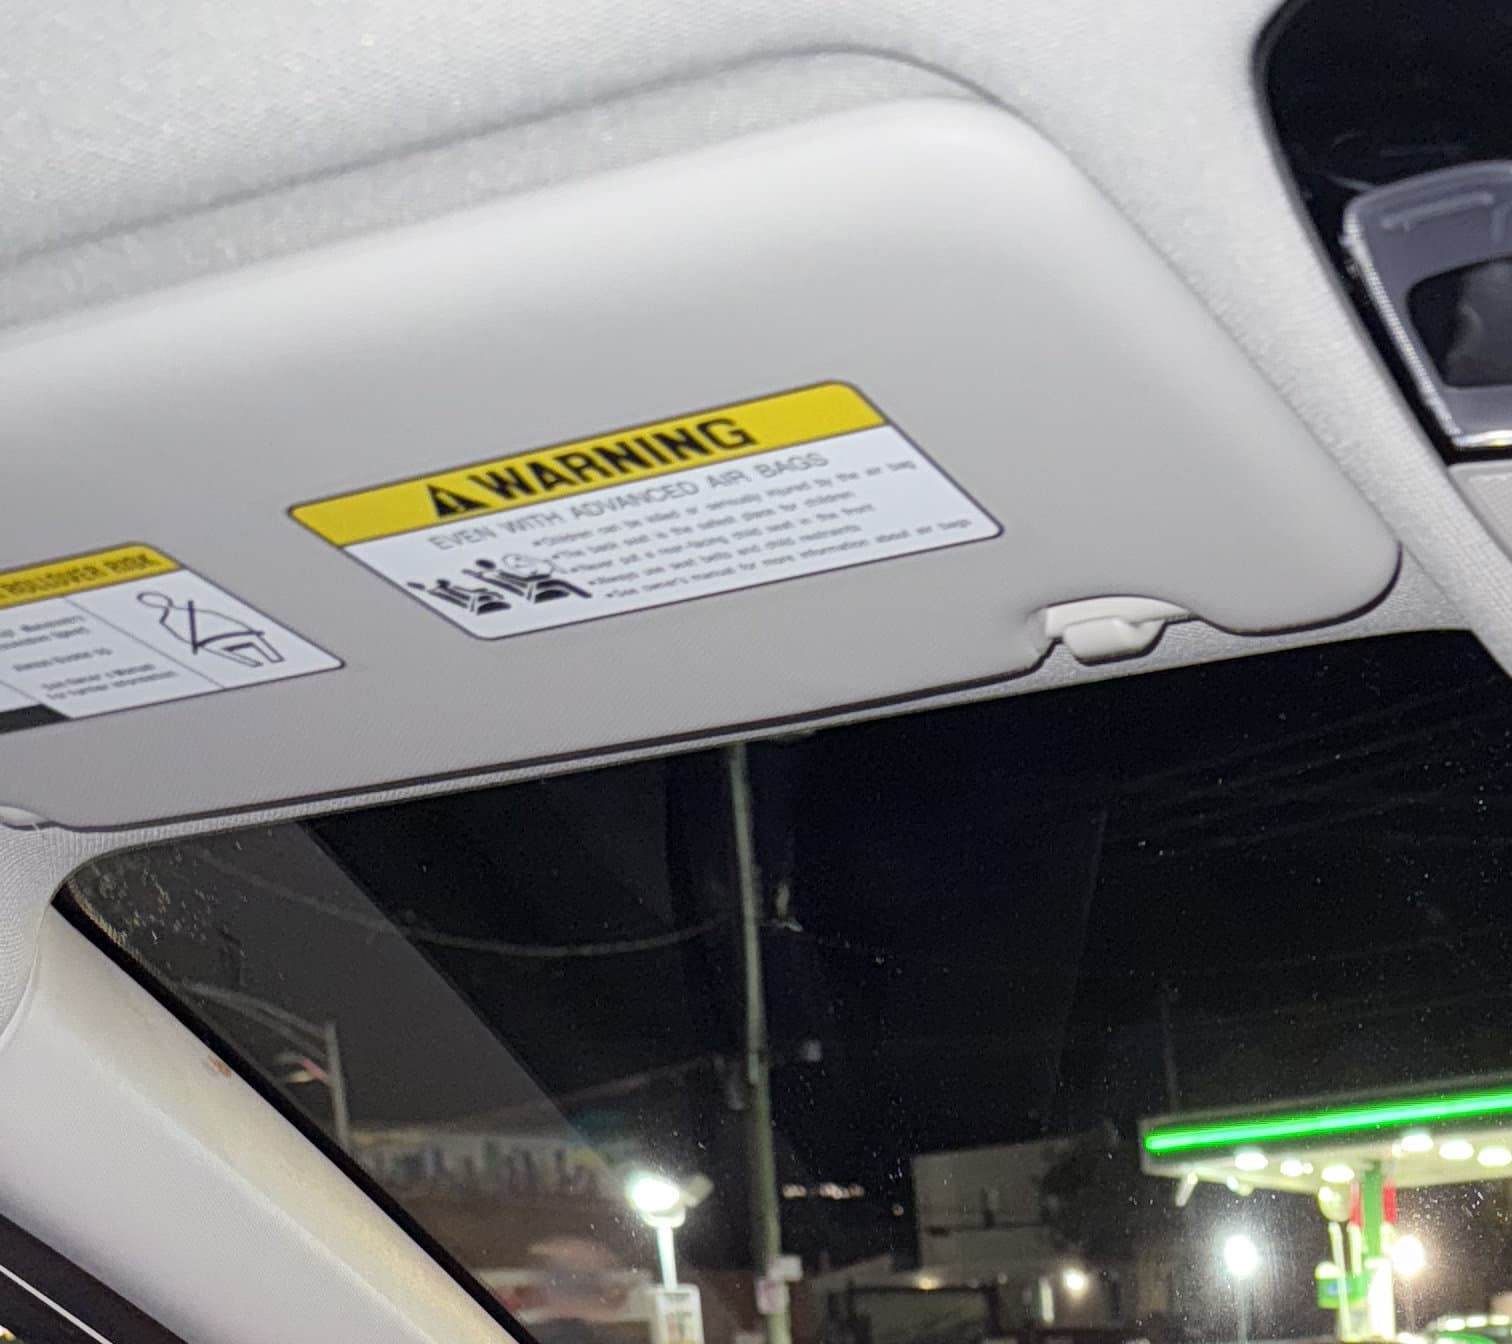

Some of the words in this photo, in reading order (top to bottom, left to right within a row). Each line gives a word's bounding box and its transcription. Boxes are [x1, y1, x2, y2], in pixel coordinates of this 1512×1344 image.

[428, 526, 497, 550] EVEN
[500, 512, 564, 534] WITH
[569, 481, 699, 520] ADVANCED
[706, 467, 751, 489] AIR
[754, 452, 829, 479] BAGS
[467, 418, 758, 501] WARNING
